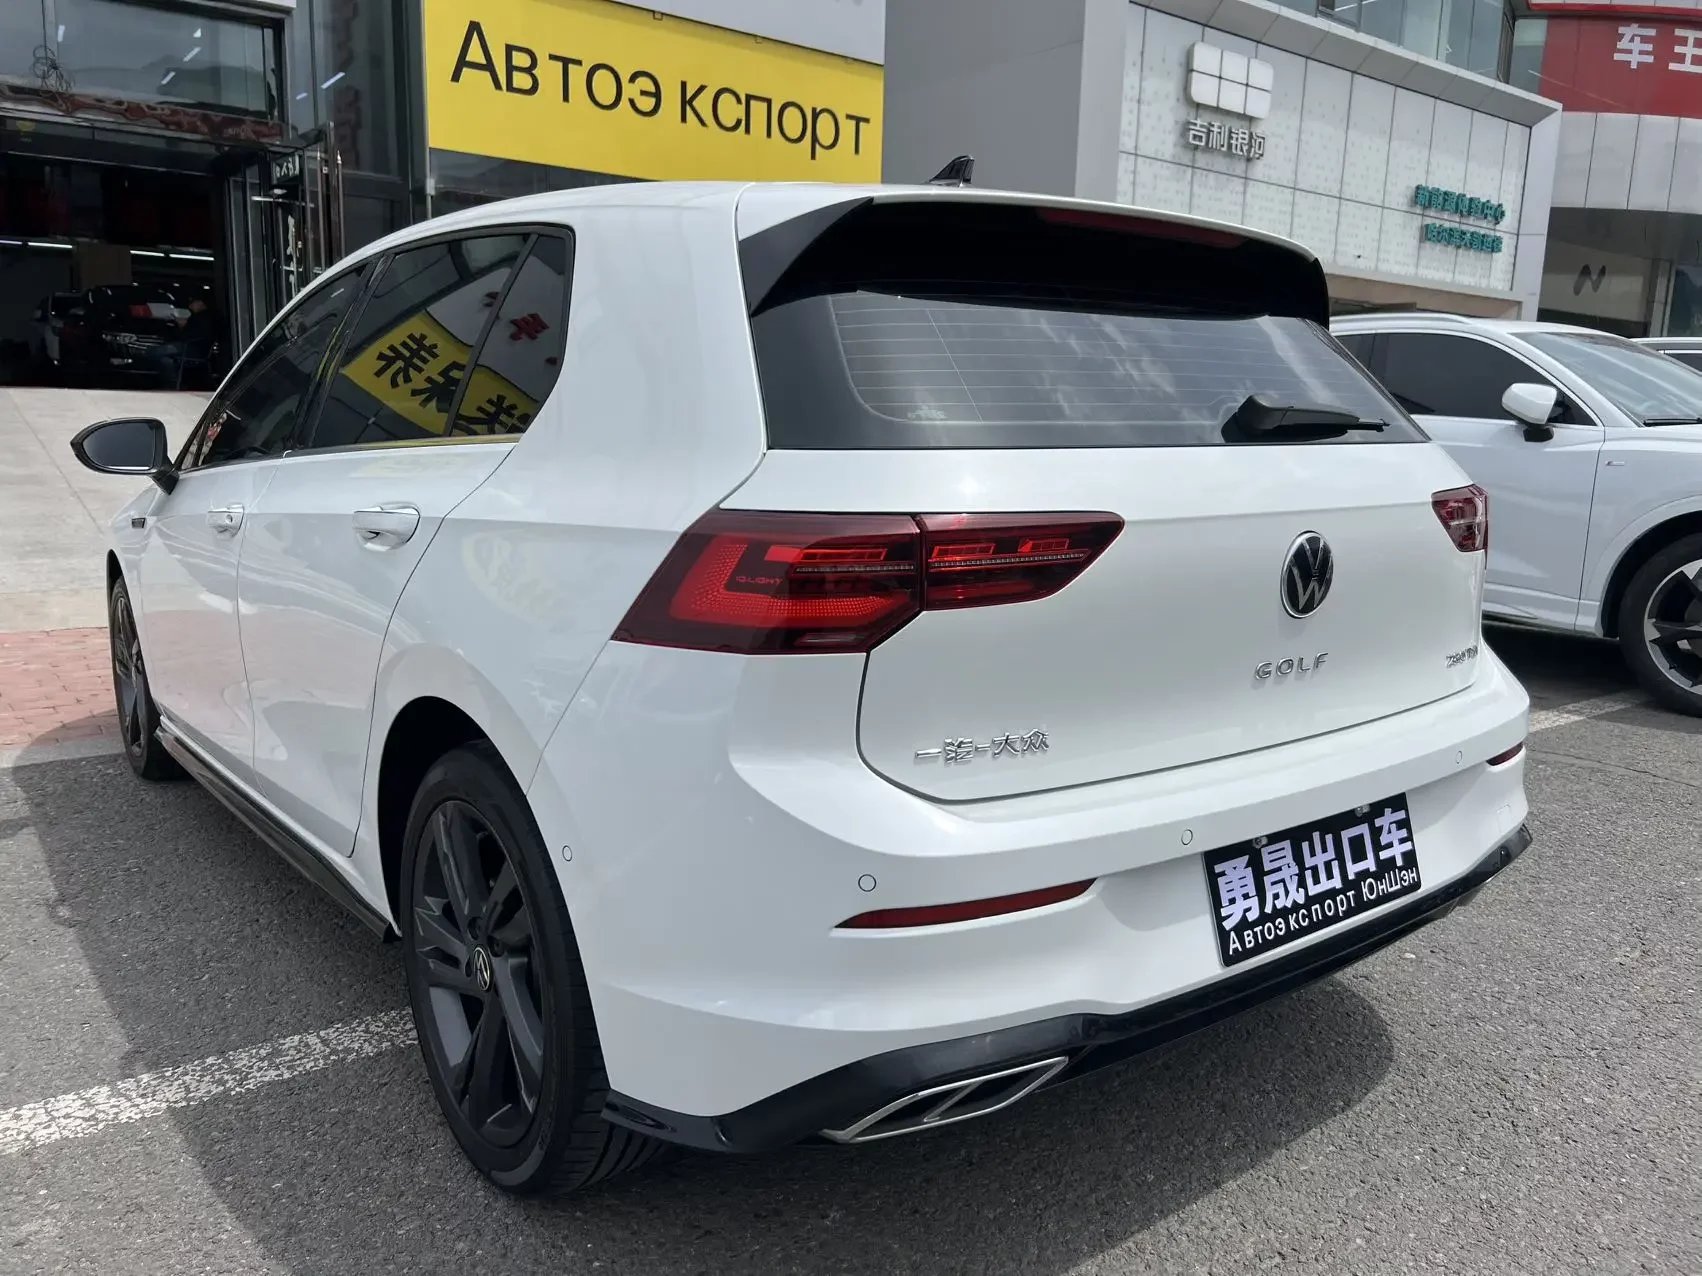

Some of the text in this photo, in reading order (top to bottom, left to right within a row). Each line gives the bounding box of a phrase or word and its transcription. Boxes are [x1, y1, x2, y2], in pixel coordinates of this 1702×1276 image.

[1187, 117, 1266, 161] 吉利银河
[1255, 652, 1328, 680] GOLF
[1213, 807, 1413, 931] 勇晟出口车
[1360, 866, 1418, 902] ЮнШэн
